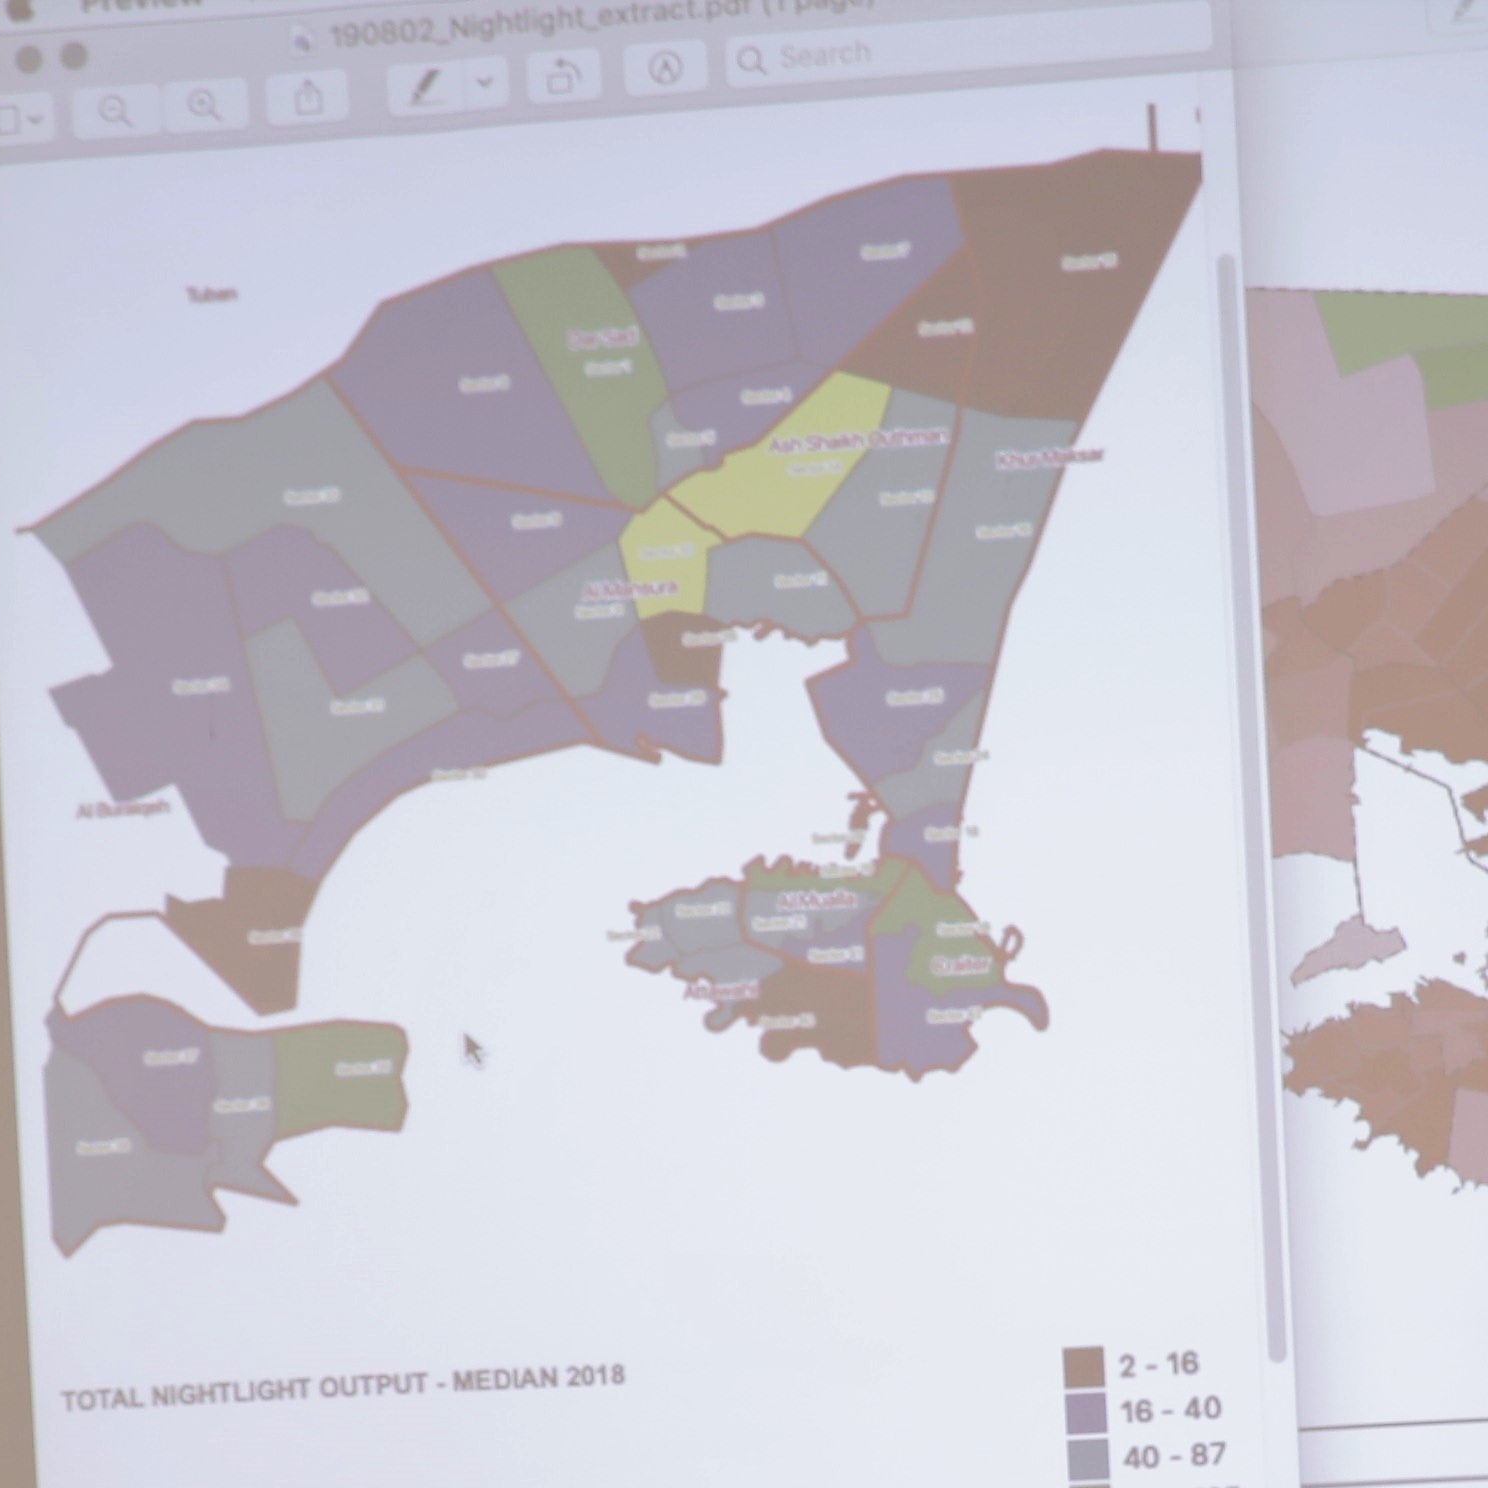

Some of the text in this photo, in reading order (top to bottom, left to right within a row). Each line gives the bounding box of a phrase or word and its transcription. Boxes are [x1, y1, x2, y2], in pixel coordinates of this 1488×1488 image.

[780, 39, 872, 69] Search
[1118, 1353, 1137, 1379] 2
[1166, 1350, 1200, 1376] 16
[60, 1387, 146, 1414] TOTAL
[151, 1376, 313, 1409] NIGHTLIGHT
[319, 1370, 430, 1401] OUTPUT
[452, 1364, 560, 1395] MEDIAN
[566, 1362, 627, 1389] 2018
[1120, 1398, 1155, 1424] 16
[1184, 1394, 1223, 1421] 40
[1122, 1444, 1161, 1470] 40
[1190, 1441, 1228, 1468] 87
